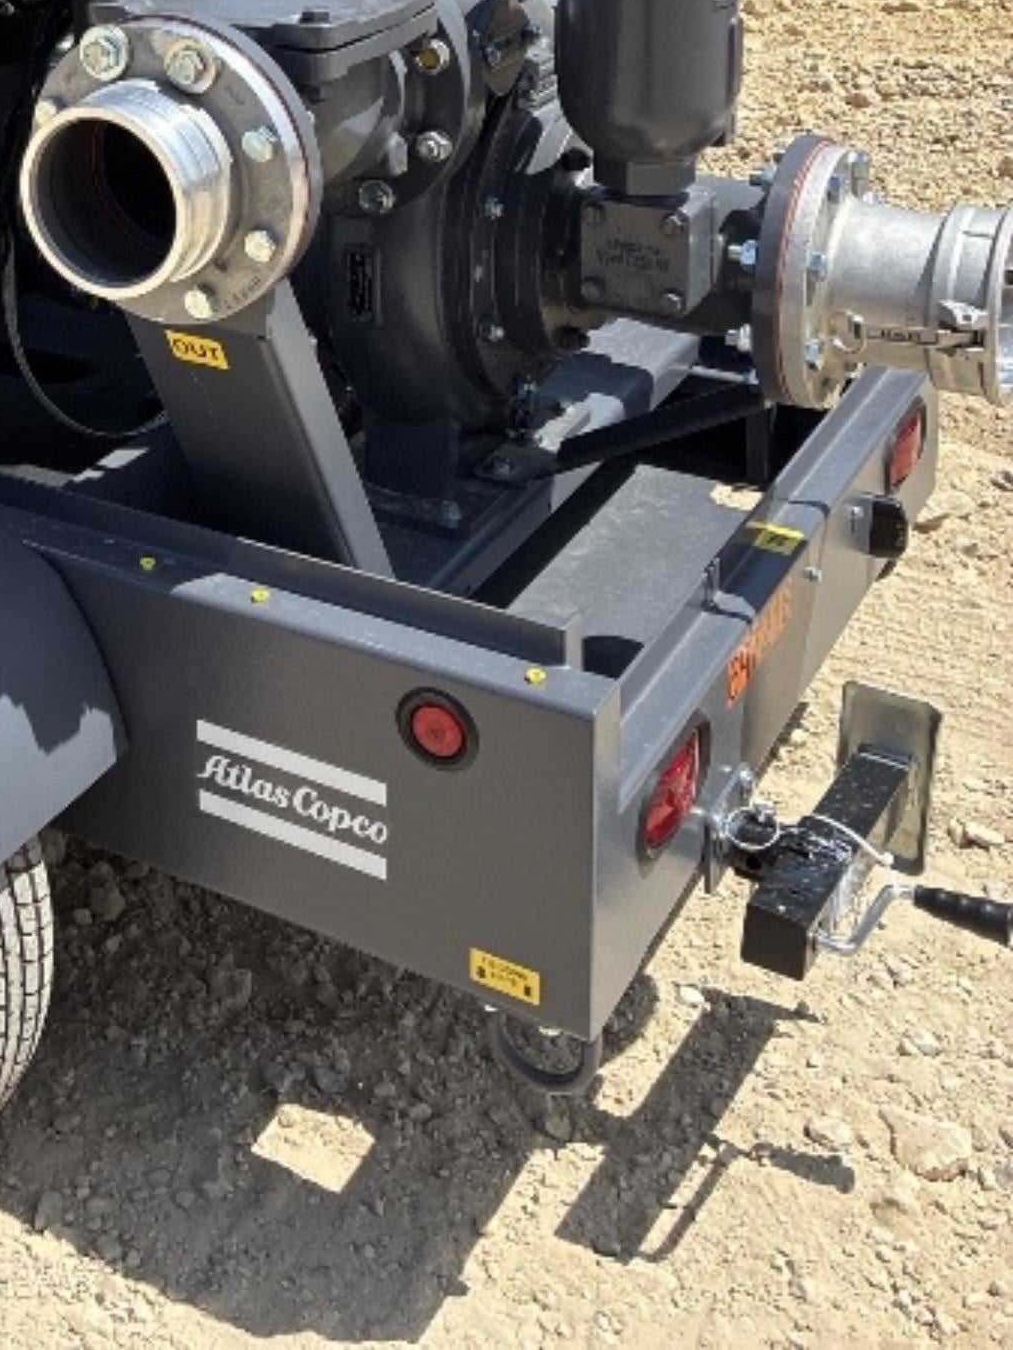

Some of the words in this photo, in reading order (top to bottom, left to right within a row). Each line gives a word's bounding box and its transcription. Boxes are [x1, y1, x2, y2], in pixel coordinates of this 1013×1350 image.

[173, 338, 219, 361] OUT
[196, 755, 290, 808] Atlas
[292, 786, 388, 844] Copco
